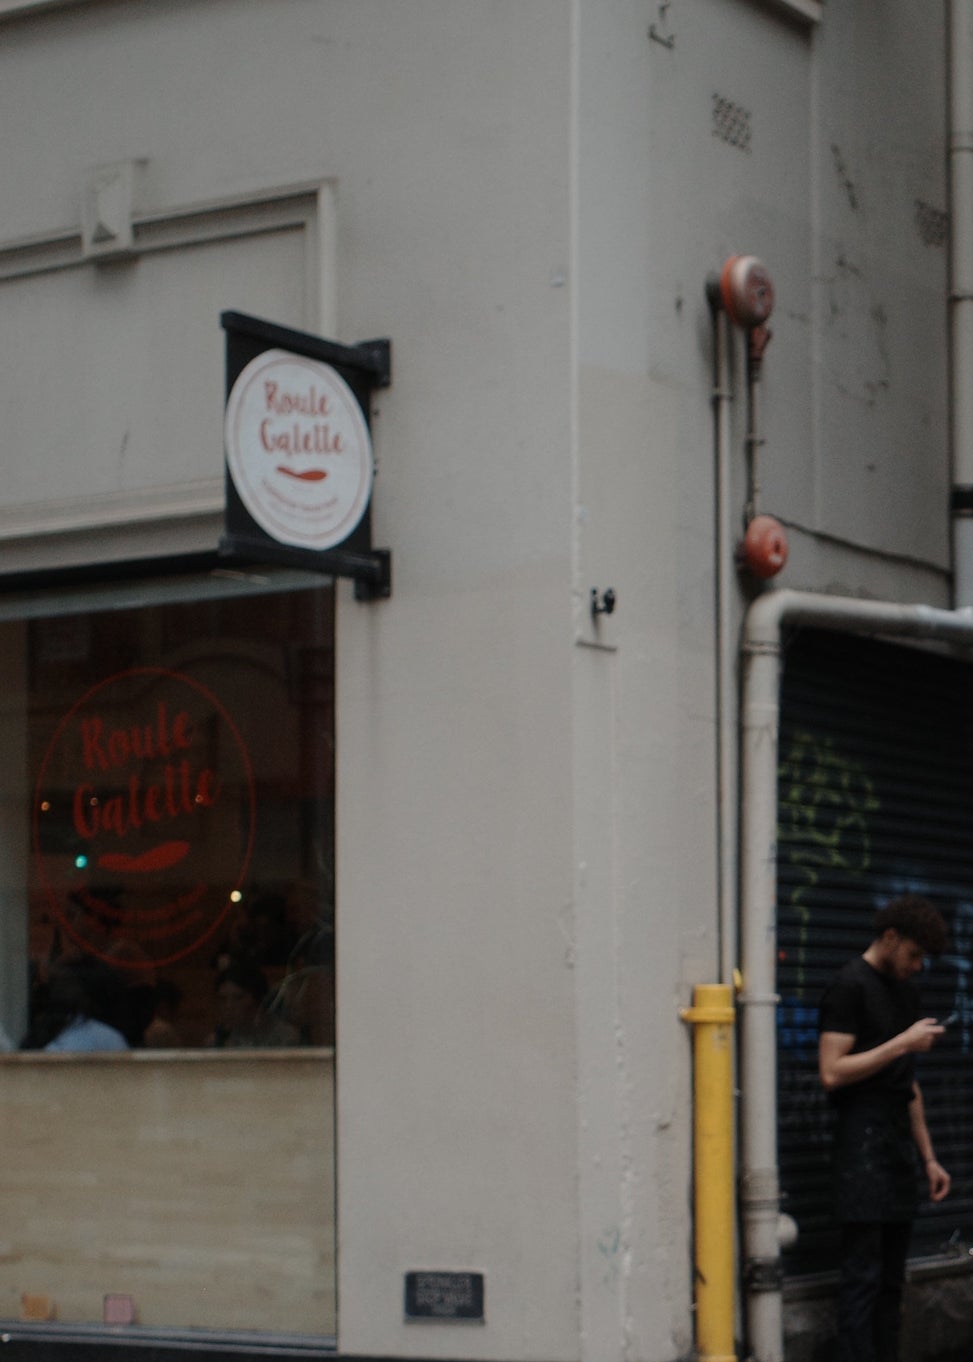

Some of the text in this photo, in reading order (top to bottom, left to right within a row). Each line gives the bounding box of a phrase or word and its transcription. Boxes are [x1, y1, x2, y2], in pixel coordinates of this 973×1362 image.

[264, 380, 330, 416] Roule
[260, 418, 343, 456] Galette
[81, 702, 193, 771] Roule
[73, 760, 217, 840] Galette
